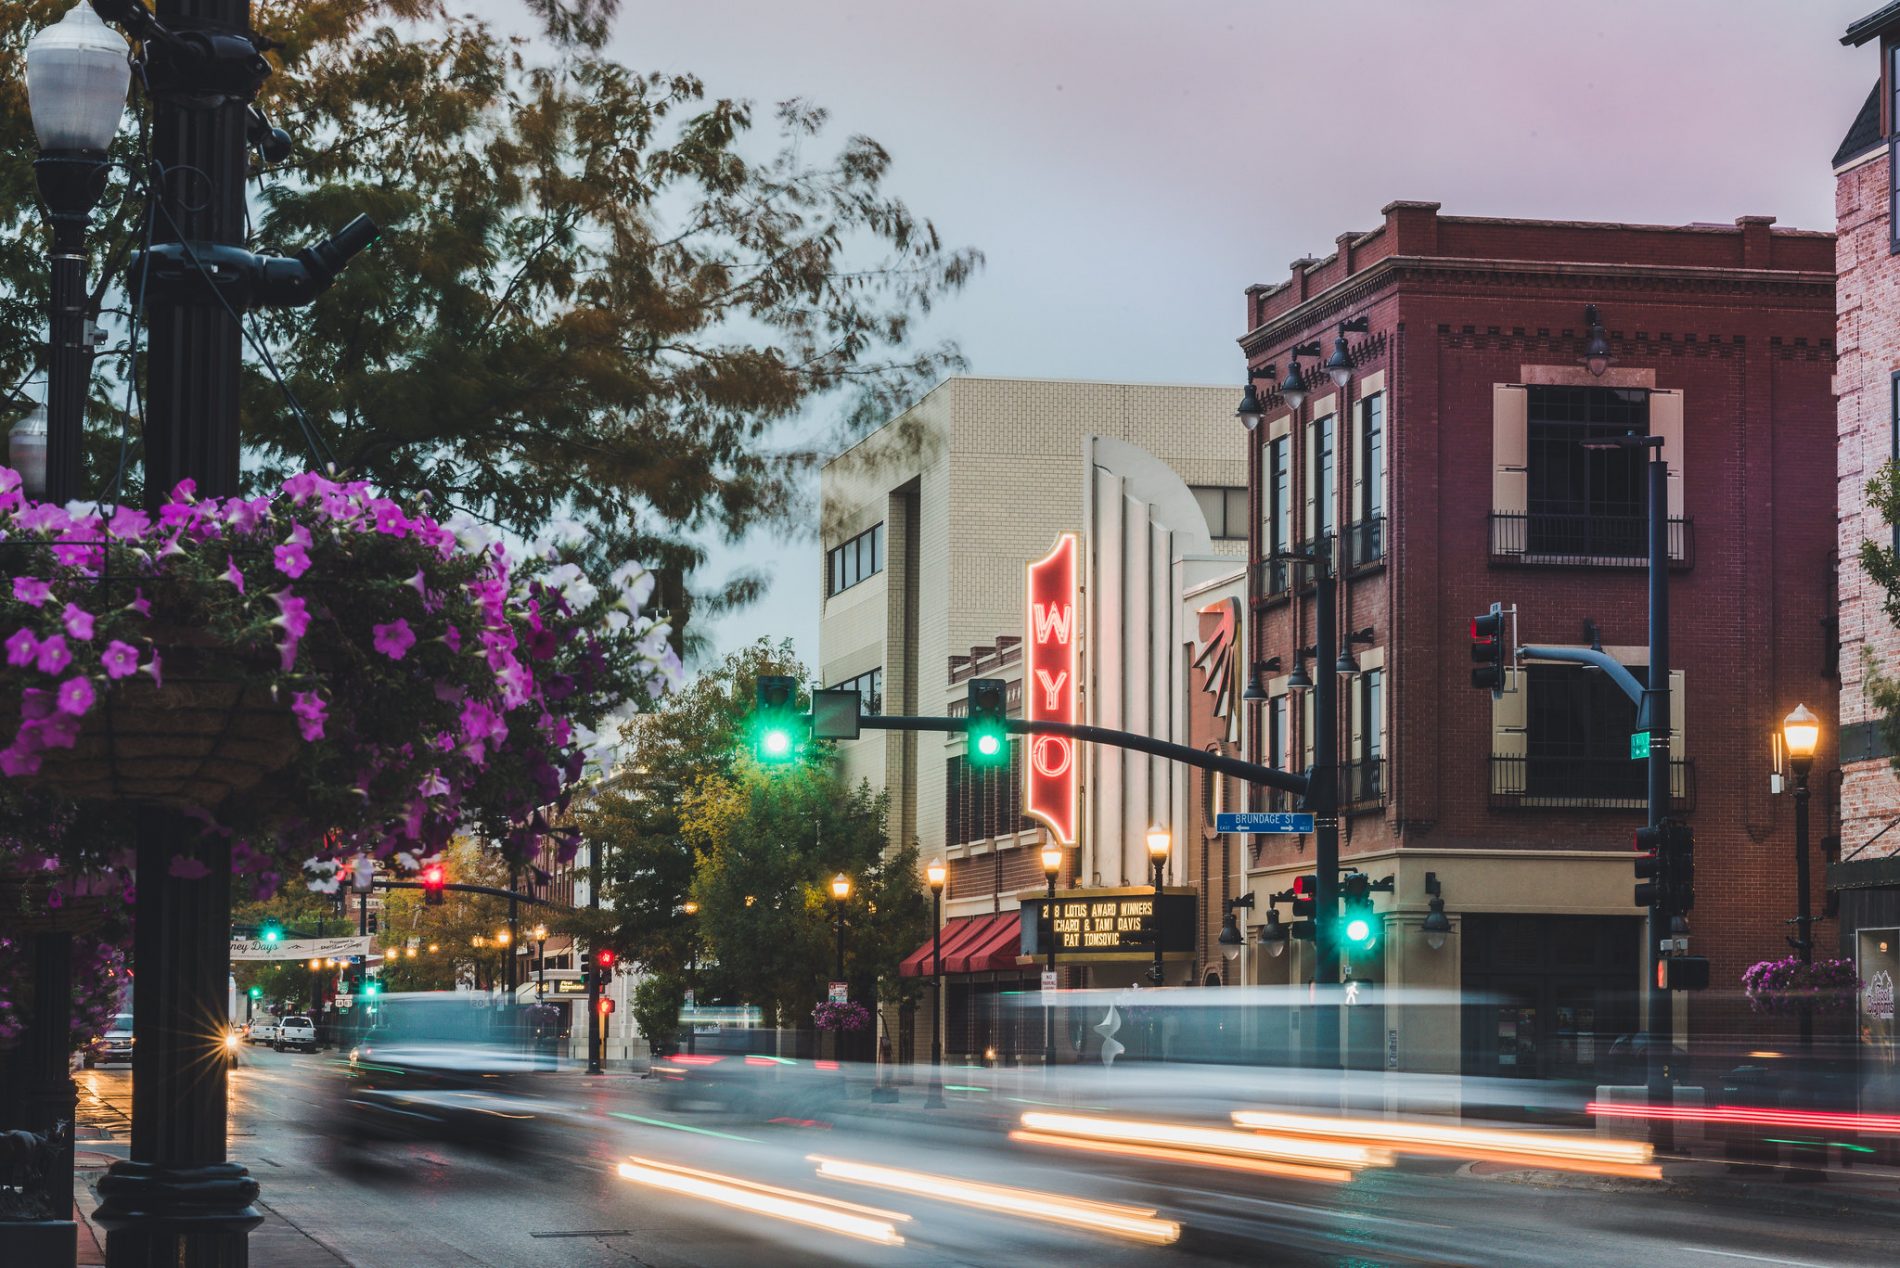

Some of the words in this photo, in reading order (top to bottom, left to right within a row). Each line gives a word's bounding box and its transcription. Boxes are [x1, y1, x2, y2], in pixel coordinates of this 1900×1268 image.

[1033, 601, 1072, 777] WYO
[1235, 814, 1280, 824] BRUNDAGE
[1285, 814, 1295, 824] ST
[1064, 904, 1087, 917] LOTUS
[1091, 903, 1116, 917] AWARD
[1120, 902, 1152, 915] WINNERS
[1053, 919, 1080, 932] ICHARD
[1084, 919, 1090, 931] &
[1095, 918, 1113, 931] TAMI
[1117, 918, 1141, 931] DAVIS
[1064, 933, 1079, 947] PAT
[1084, 933, 1119, 946] TOMSOVIC
[250, 941, 279, 954] Days
